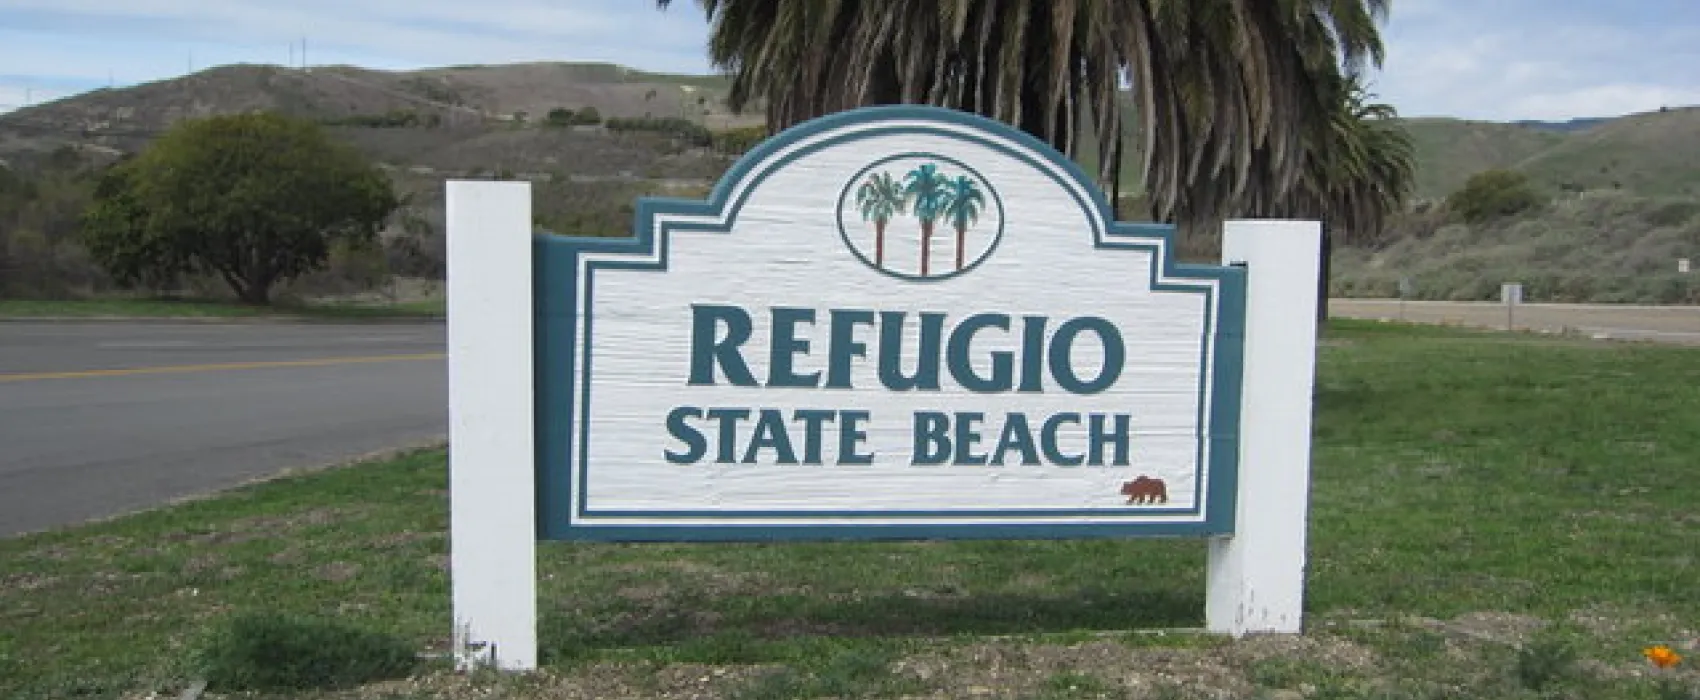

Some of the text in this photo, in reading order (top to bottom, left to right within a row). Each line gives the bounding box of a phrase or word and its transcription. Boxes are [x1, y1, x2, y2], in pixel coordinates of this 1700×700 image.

[687, 303, 1126, 395] REFUGIO
[663, 406, 1132, 467] STATE BEACH
